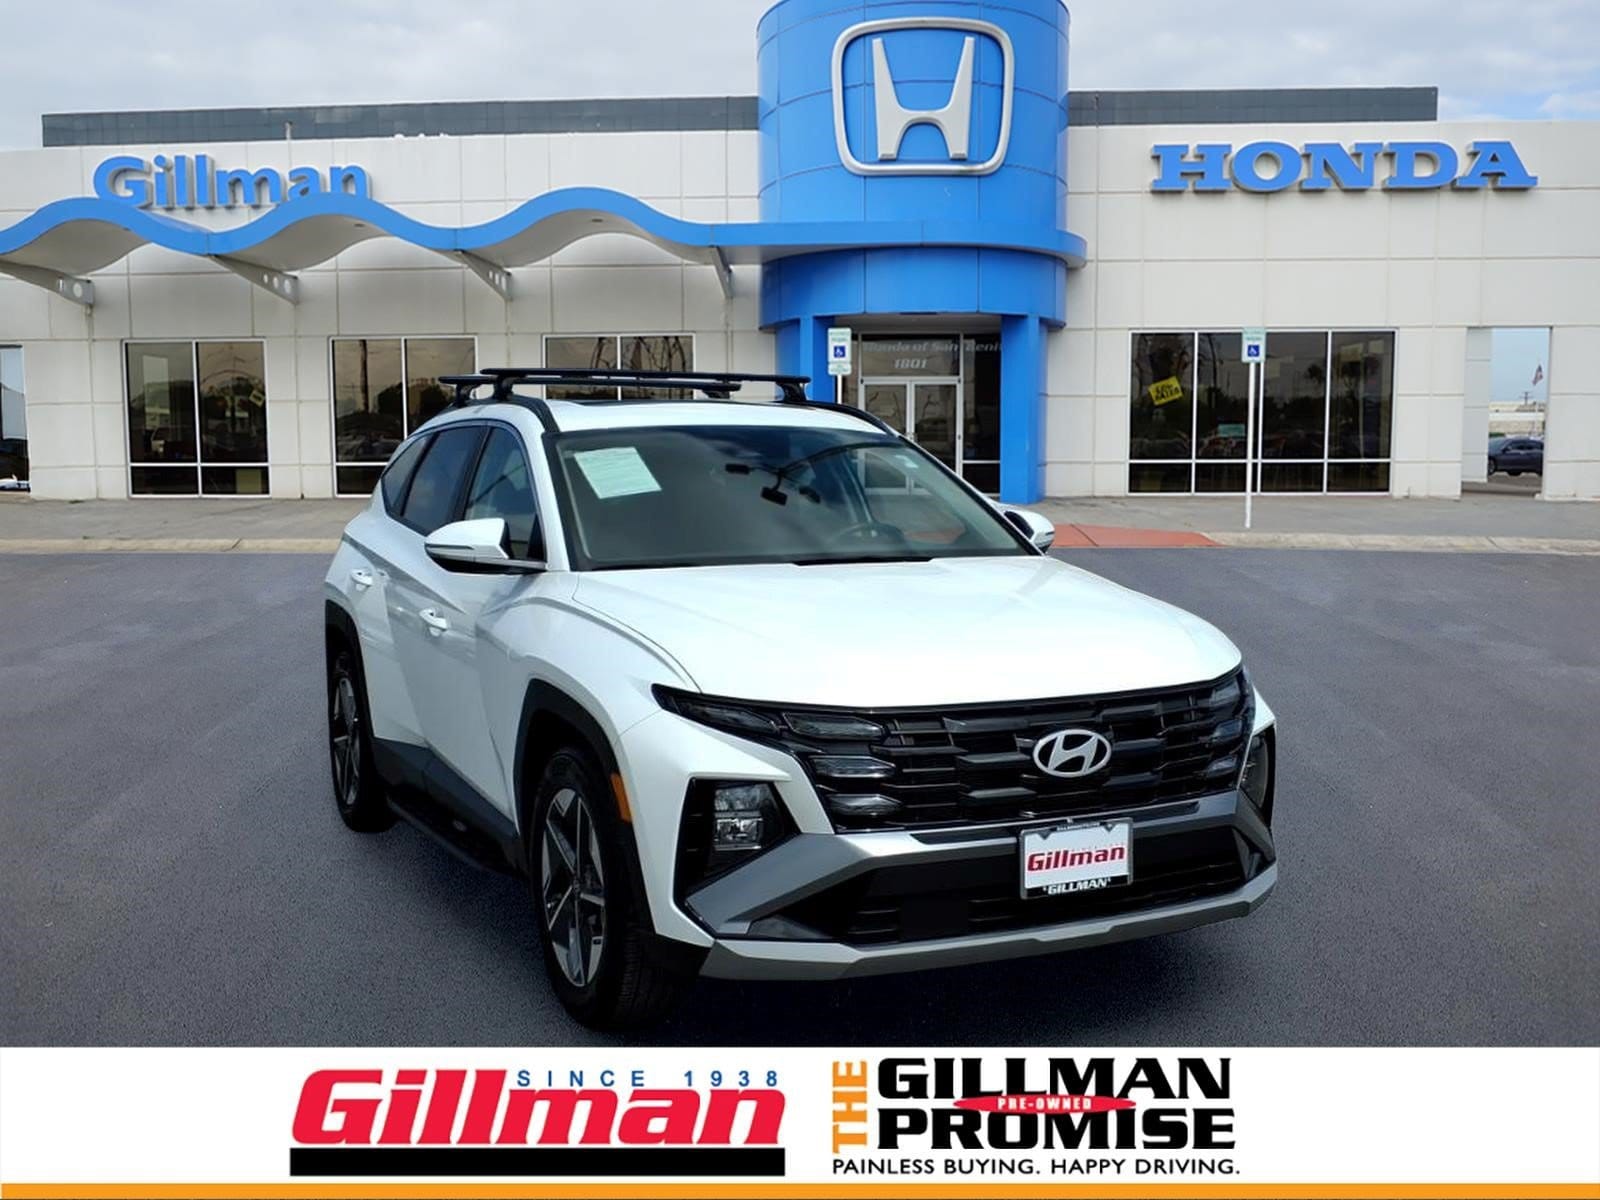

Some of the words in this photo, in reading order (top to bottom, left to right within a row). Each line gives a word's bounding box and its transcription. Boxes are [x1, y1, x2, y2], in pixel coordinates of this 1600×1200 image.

[1151, 141, 1539, 192] HONDA
[93, 154, 371, 208] Gillman
[965, 340, 1002, 352] Beni
[893, 358, 927, 369] 1801
[1027, 846, 1125, 872] Gillman
